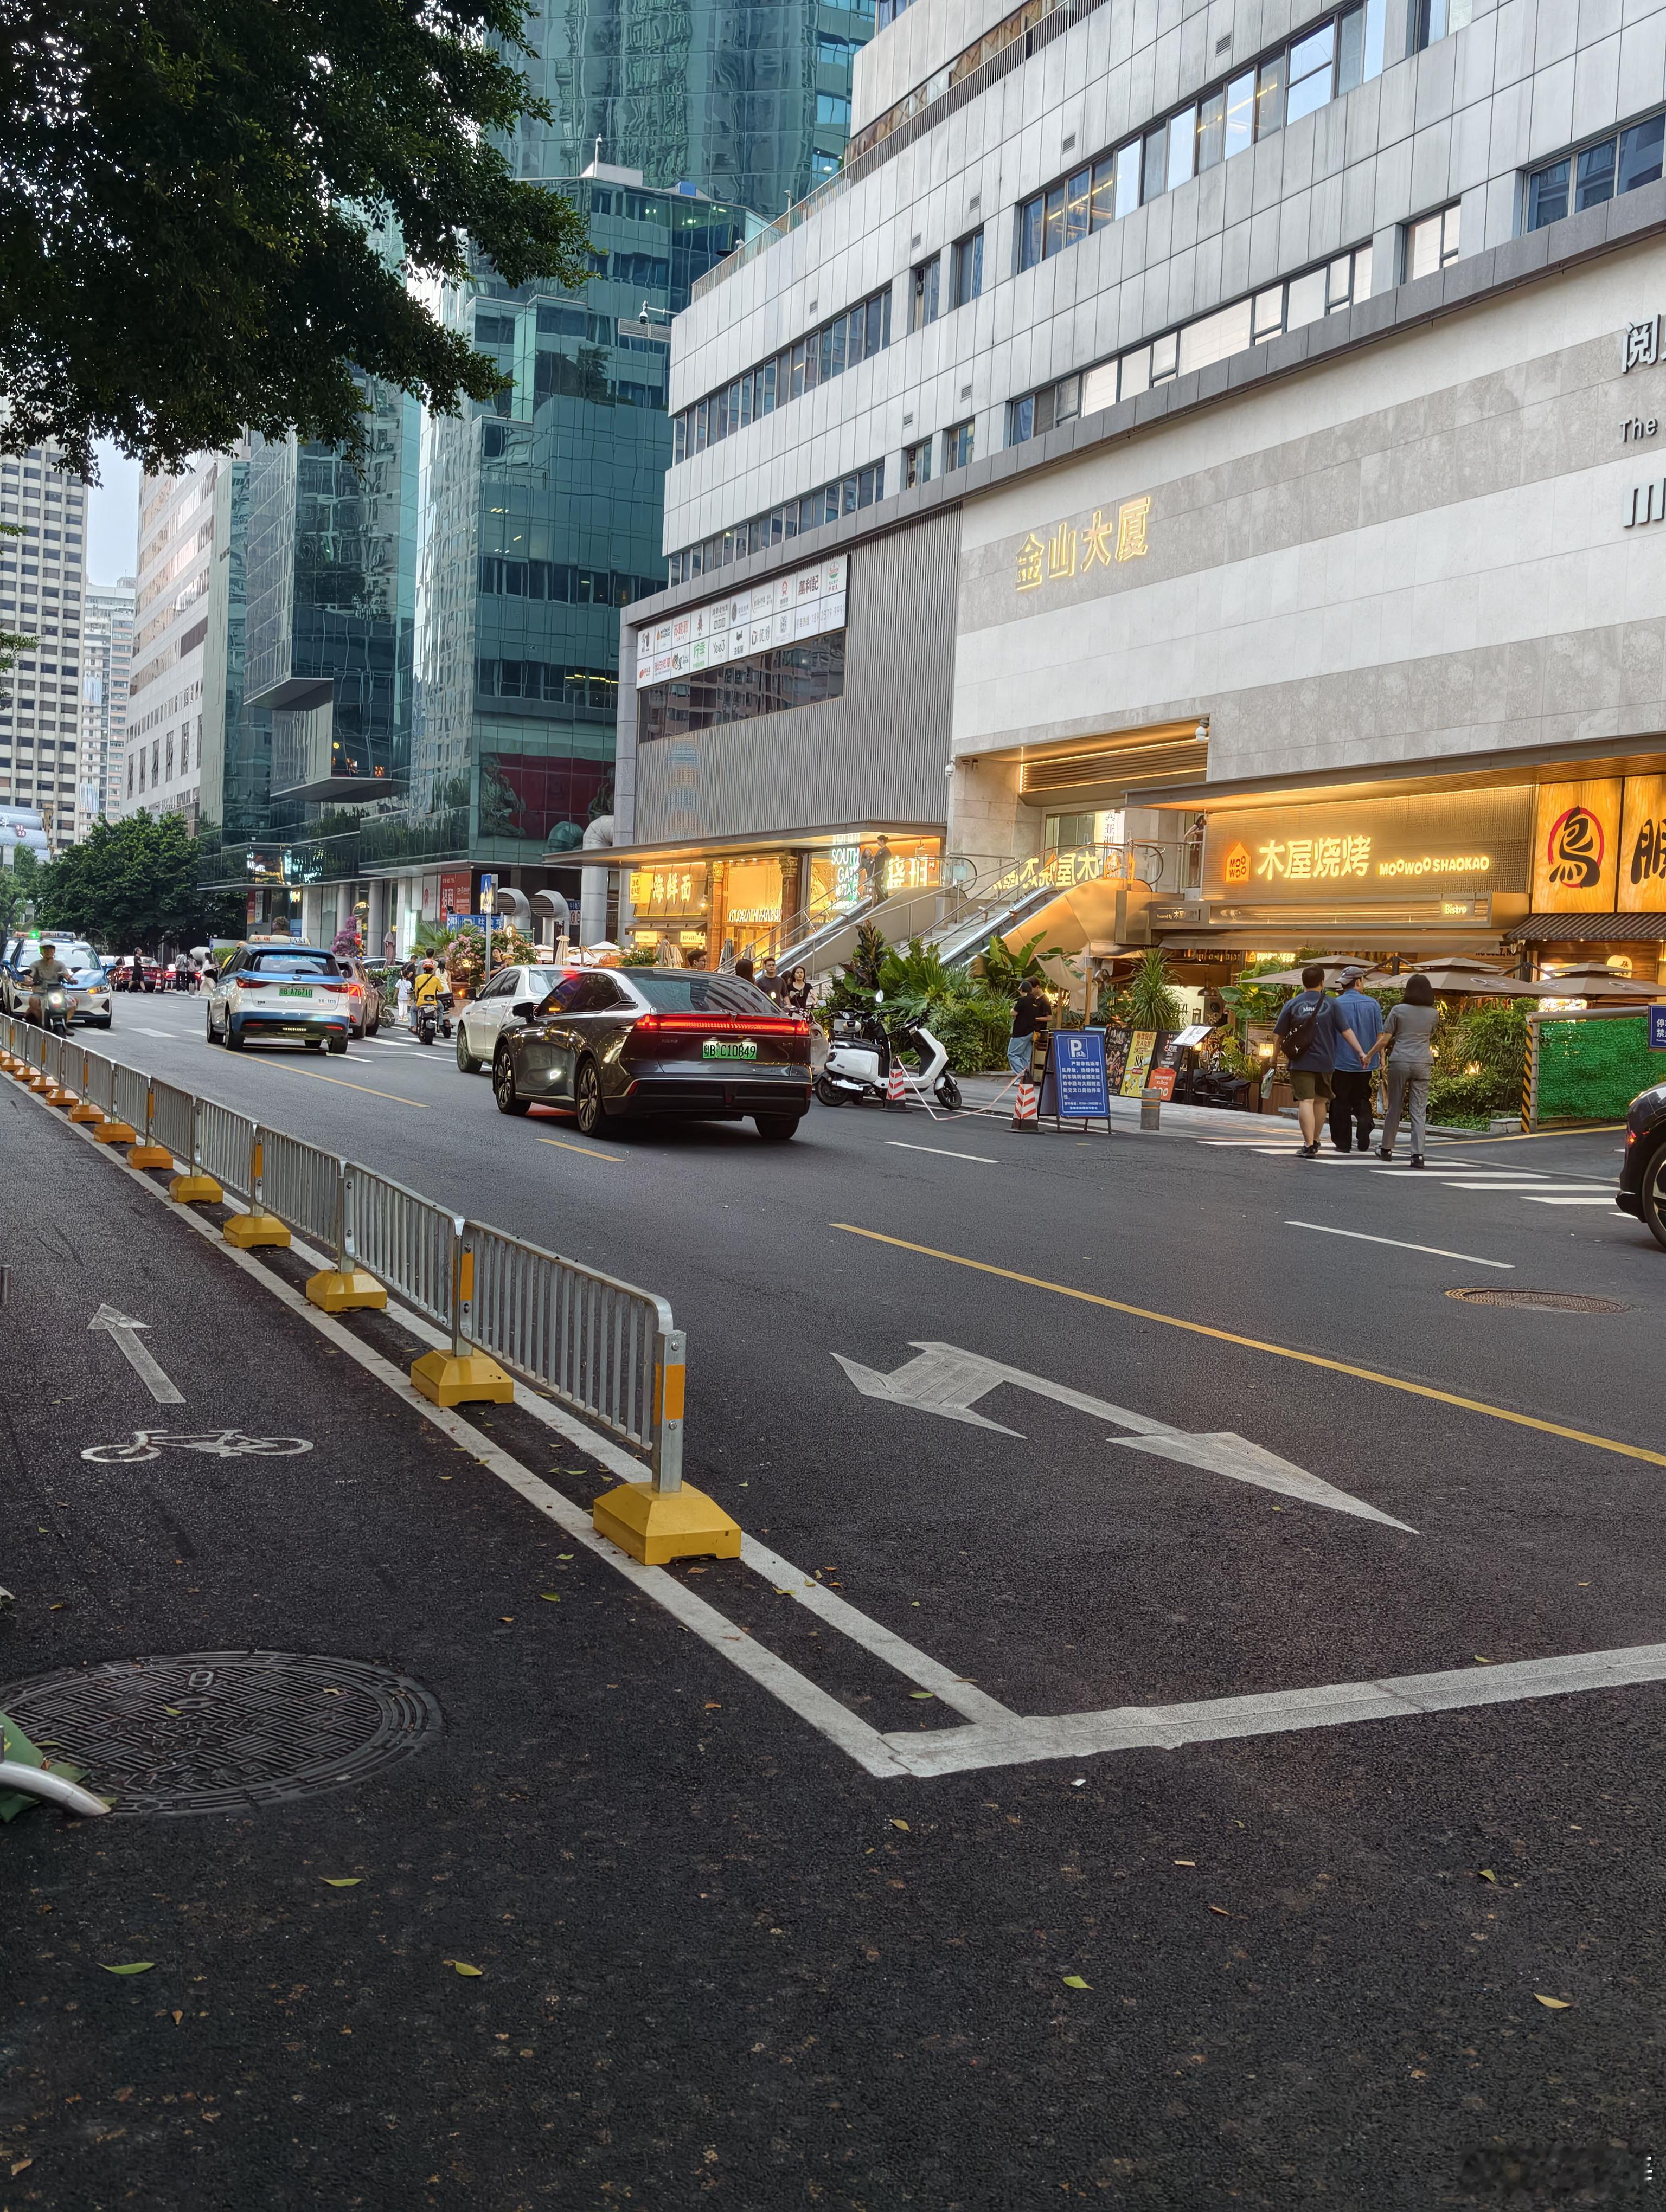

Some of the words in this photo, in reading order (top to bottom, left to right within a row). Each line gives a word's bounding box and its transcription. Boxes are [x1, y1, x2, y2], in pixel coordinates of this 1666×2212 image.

[1619, 417, 1658, 442] The
[1015, 496, 1151, 591] 金山大厦
[798, 575, 819, 596] 萬利記
[831, 847, 860, 865] SOUTH
[1229, 856, 1246, 867] MOO
[1258, 835, 1372, 880] 木屋烧烤
[1229, 866, 1246, 878] WOO
[1379, 857, 1432, 876] MOOWOO
[1432, 856, 1490, 872] SHAOKAO
[1445, 904, 1467, 915] Bistro
[1657, 1019, 1666, 1027] 停
[1657, 1028, 1666, 1037] 禁
